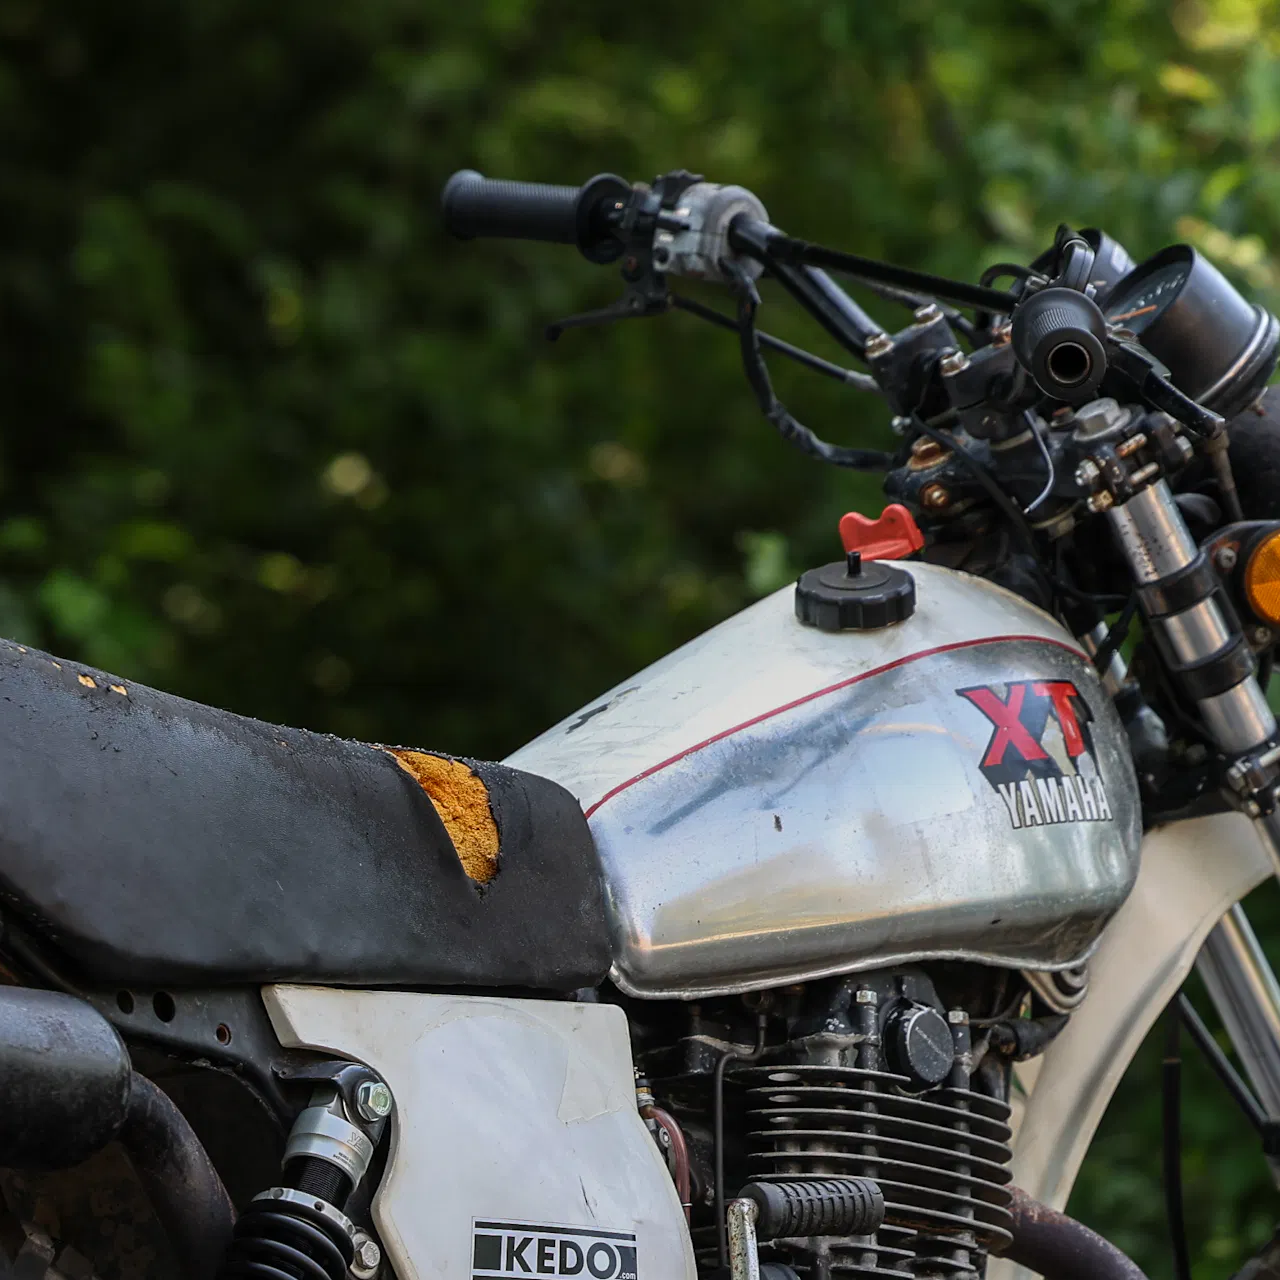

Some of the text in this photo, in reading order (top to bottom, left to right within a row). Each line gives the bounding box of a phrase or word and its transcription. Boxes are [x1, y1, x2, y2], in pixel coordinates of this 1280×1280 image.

[960, 681, 1089, 768] XT
[997, 774, 1113, 829] YAMAHA
[505, 1235, 618, 1280] KEDO
